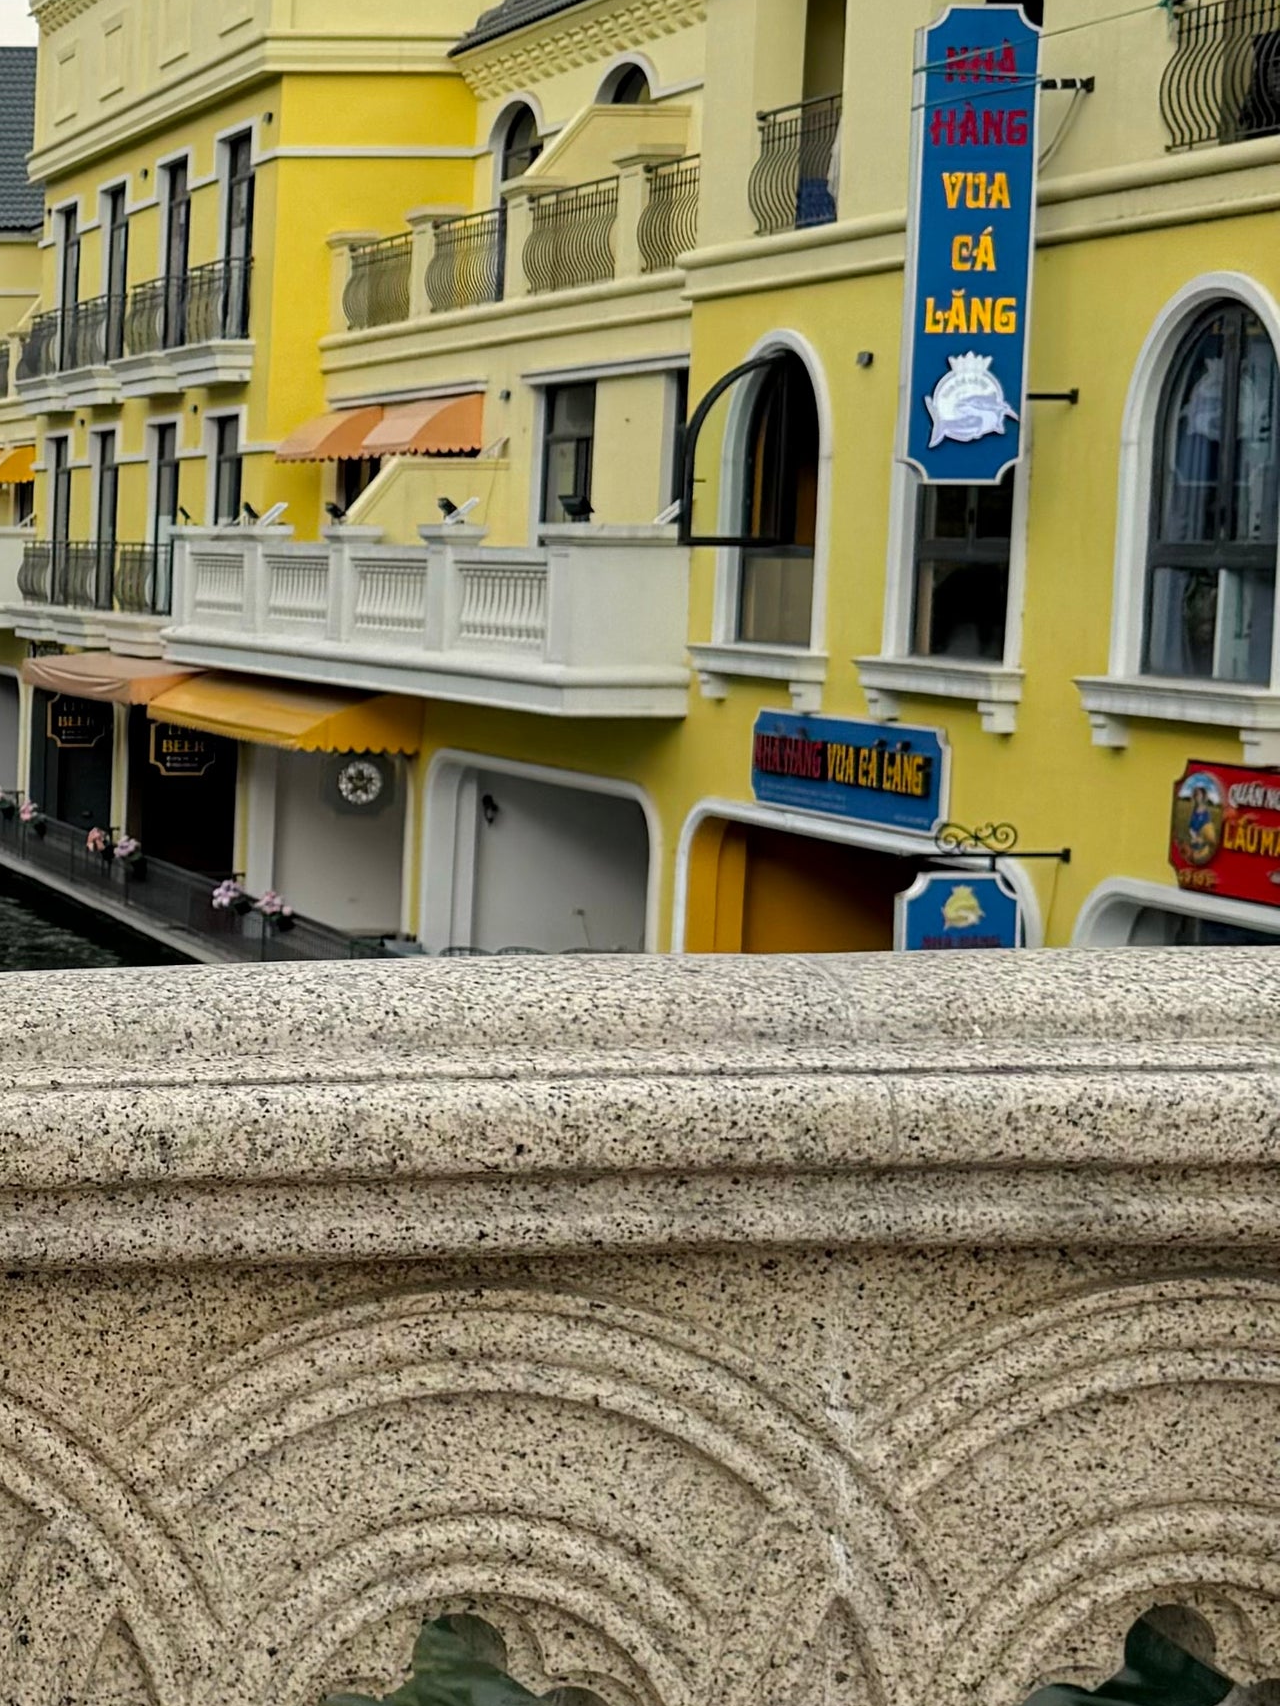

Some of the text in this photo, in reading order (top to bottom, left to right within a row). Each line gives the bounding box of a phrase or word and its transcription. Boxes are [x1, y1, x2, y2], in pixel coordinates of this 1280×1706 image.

[945, 38, 1019, 83] NHÀ
[929, 101, 1028, 146] HÀNG
[942, 171, 1011, 209] VUA
[951, 225, 997, 272] CÁ
[924, 288, 1017, 334] LĂNG
[826, 742, 856, 785] VUA
